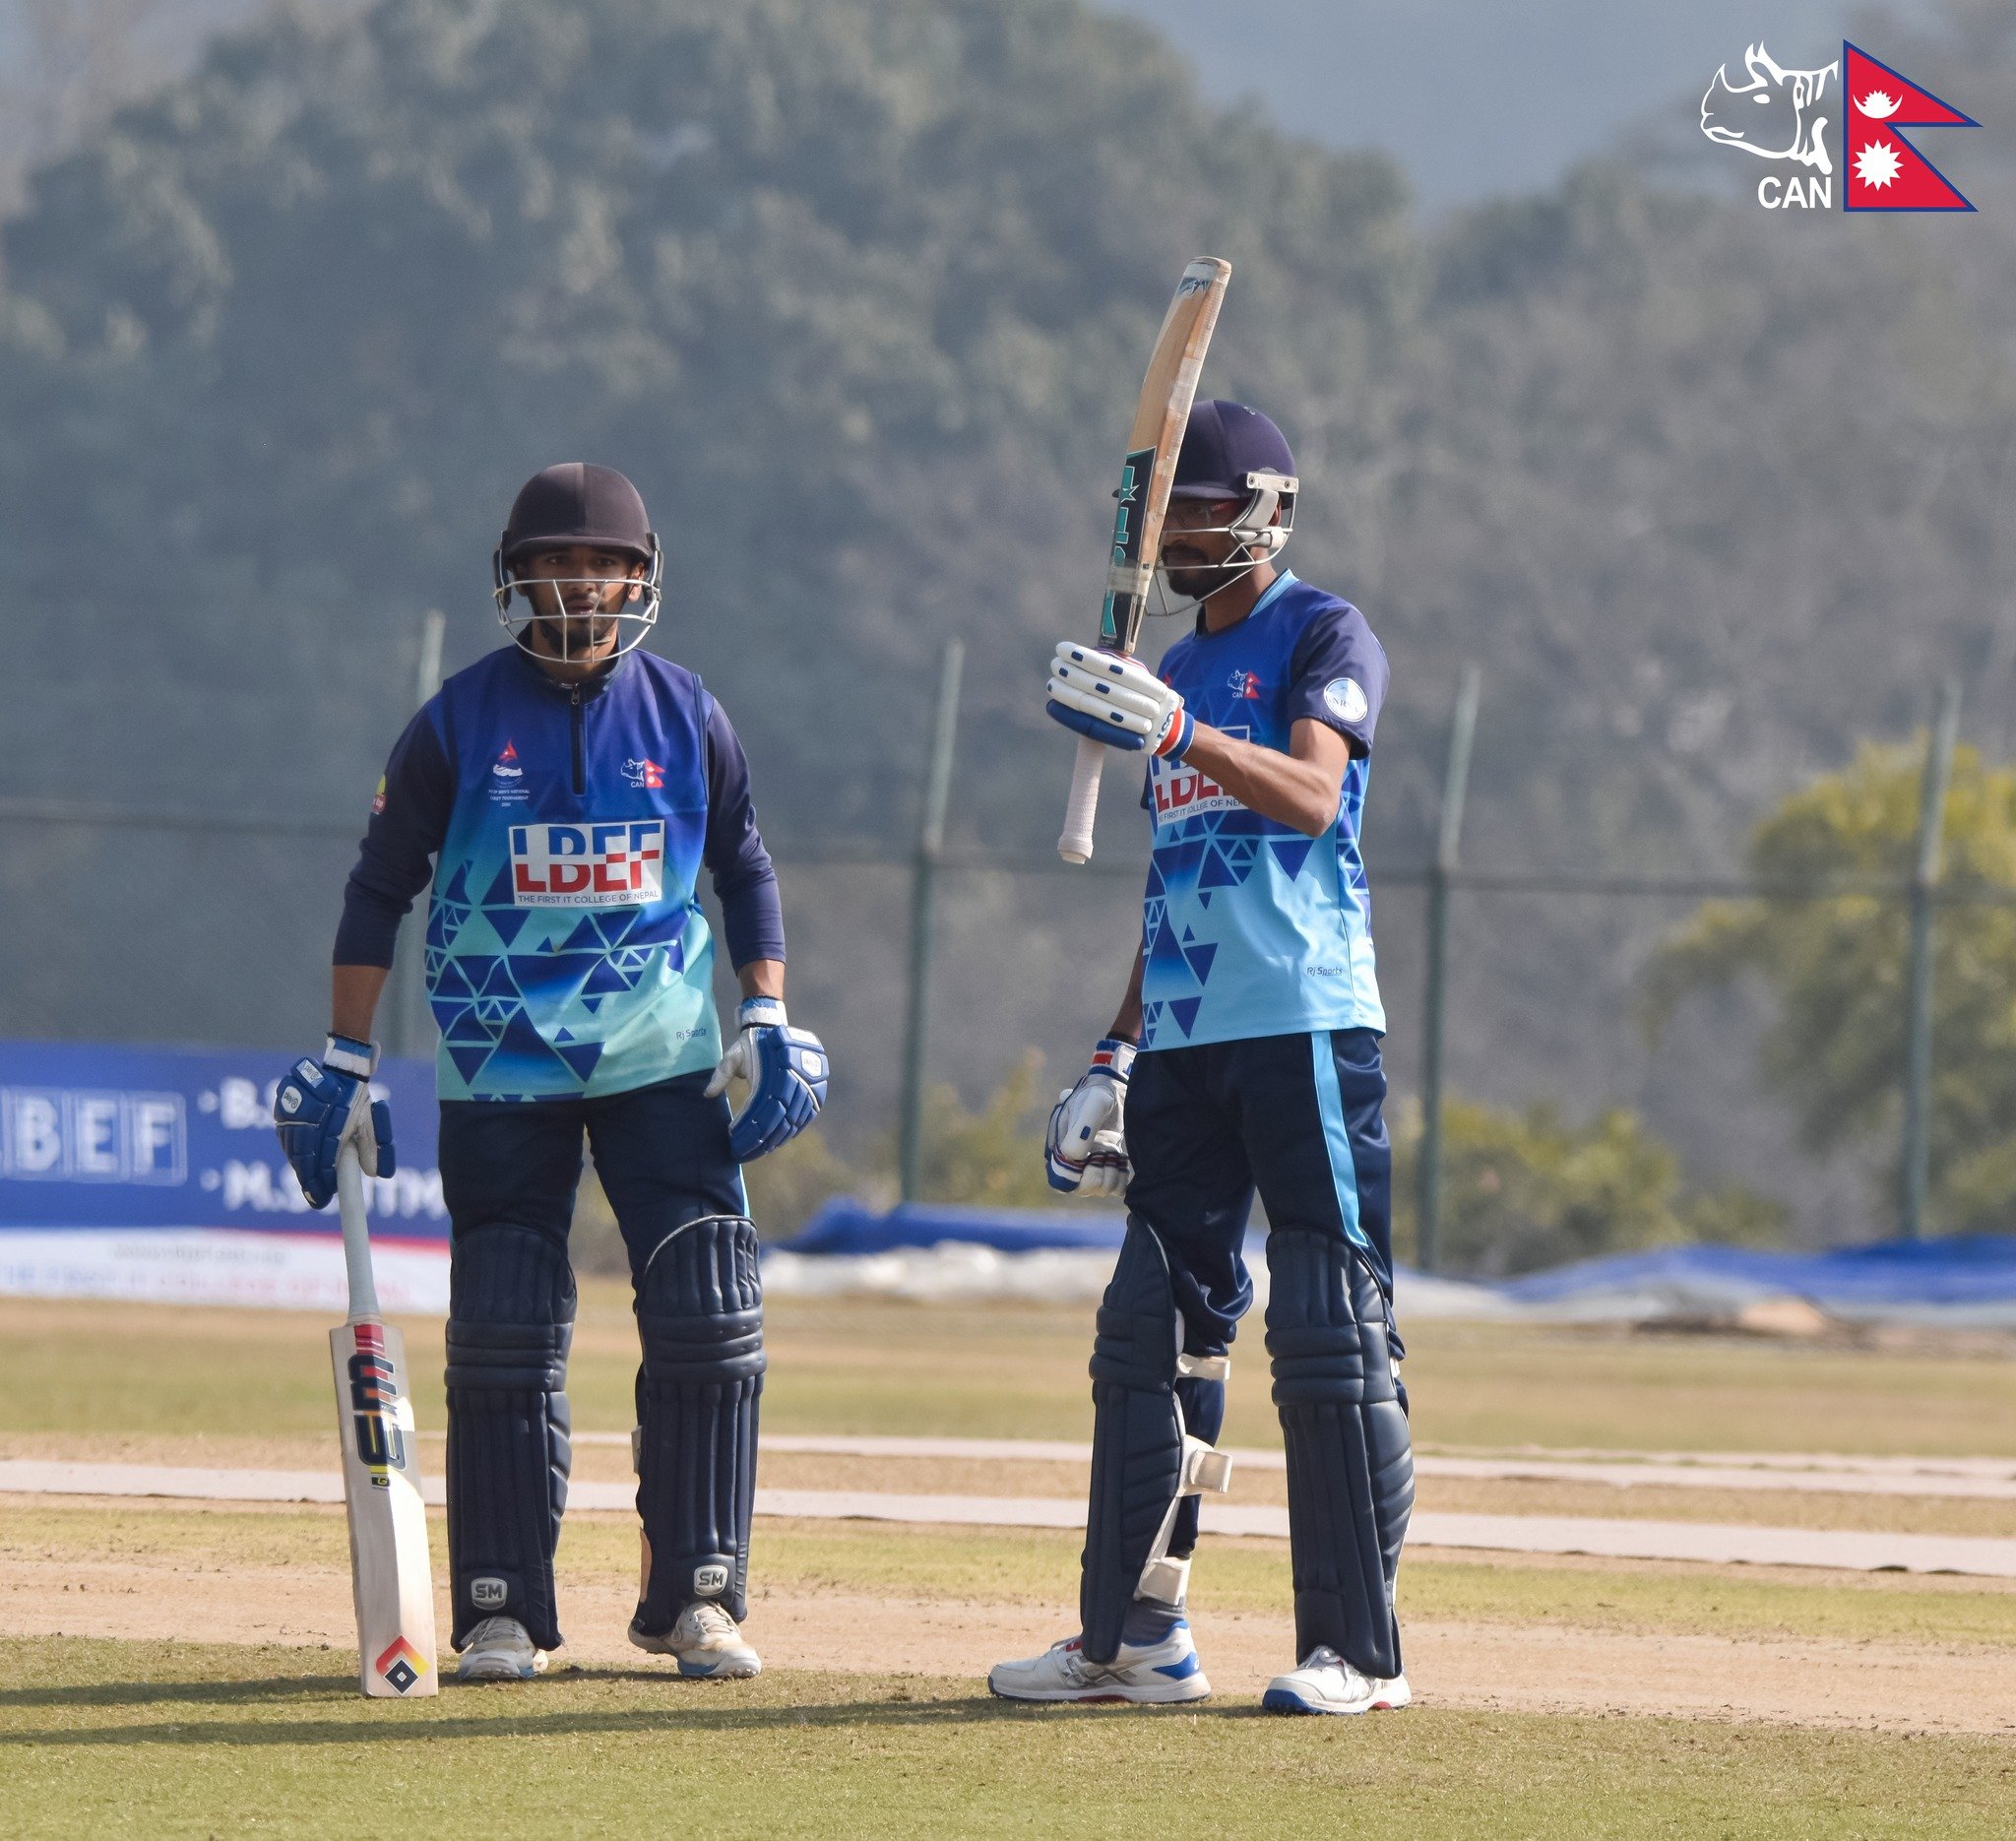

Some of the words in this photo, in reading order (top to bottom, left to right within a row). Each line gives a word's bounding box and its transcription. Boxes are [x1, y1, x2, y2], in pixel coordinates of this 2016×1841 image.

[574, 895, 617, 904] COLLEGE
[634, 890, 659, 900] NEPAL
[2, 1096, 177, 1175] BEF
[698, 1571, 724, 1586] SM
[475, 1584, 502, 1599] SM
